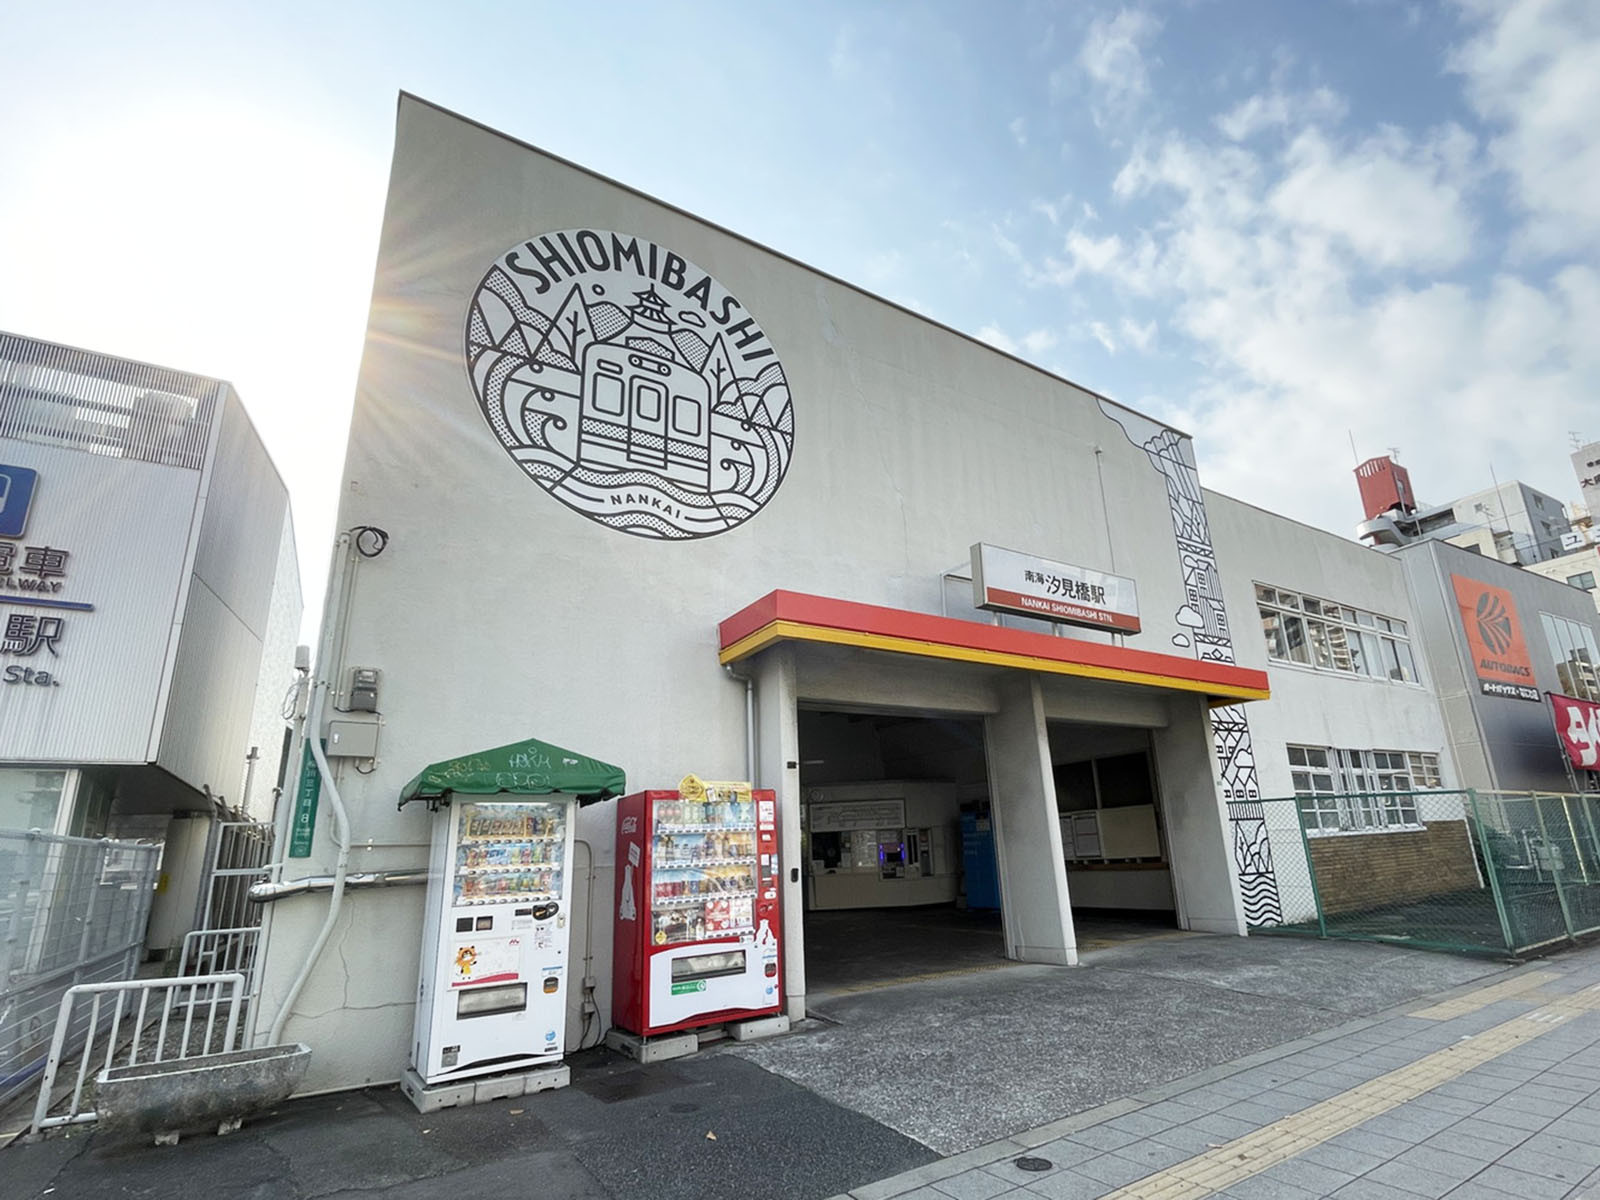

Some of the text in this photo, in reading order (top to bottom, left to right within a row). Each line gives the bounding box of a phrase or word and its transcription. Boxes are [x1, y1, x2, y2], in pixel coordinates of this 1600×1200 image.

[505, 230, 774, 362] SHIOMIBASHI
[610, 493, 681, 520] NANKAI
[1021, 597, 1051, 611] NANKAI
[1051, 603, 1097, 619] SHIOMIBASHI
[2, 614, 63, 658] 駅
[3, 664, 60, 687] Sta.
[1480, 659, 1531, 677] AUTOBACS
